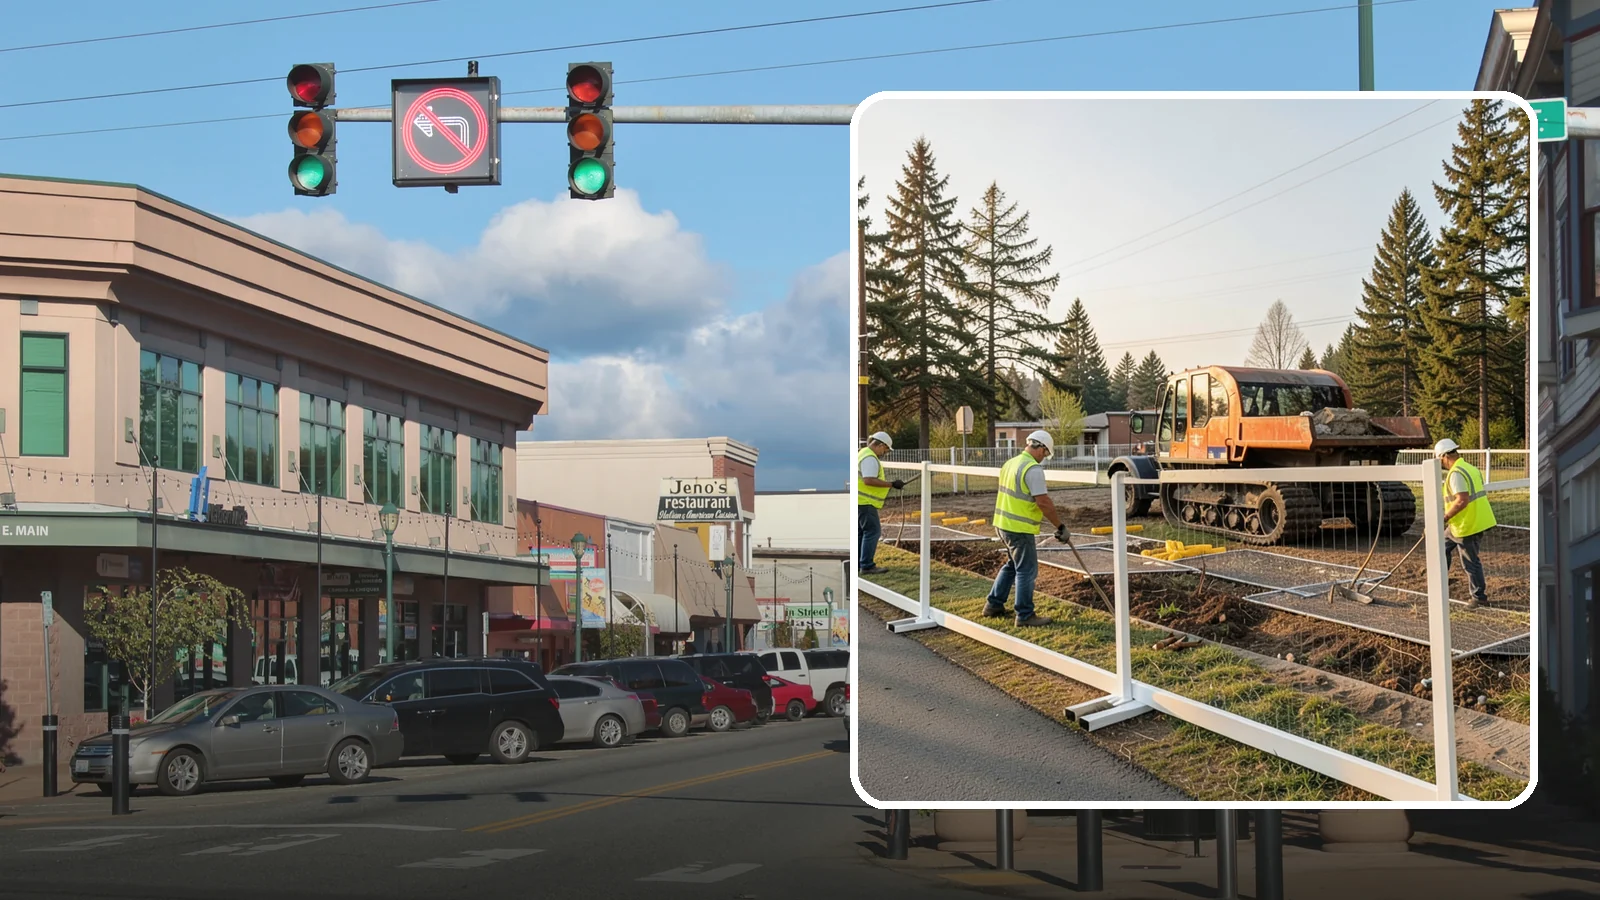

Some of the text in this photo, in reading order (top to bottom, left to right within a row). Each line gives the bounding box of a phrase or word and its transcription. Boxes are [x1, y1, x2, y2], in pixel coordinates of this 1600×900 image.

[669, 480, 727, 495] Jeno's
[665, 496, 731, 509] restaurant
[658, 509, 681, 520] Italian
[686, 509, 715, 519] American
[715, 509, 738, 519] Cuisine
[2, 525, 49, 536] E. MAIN
[797, 607, 829, 617] Street
